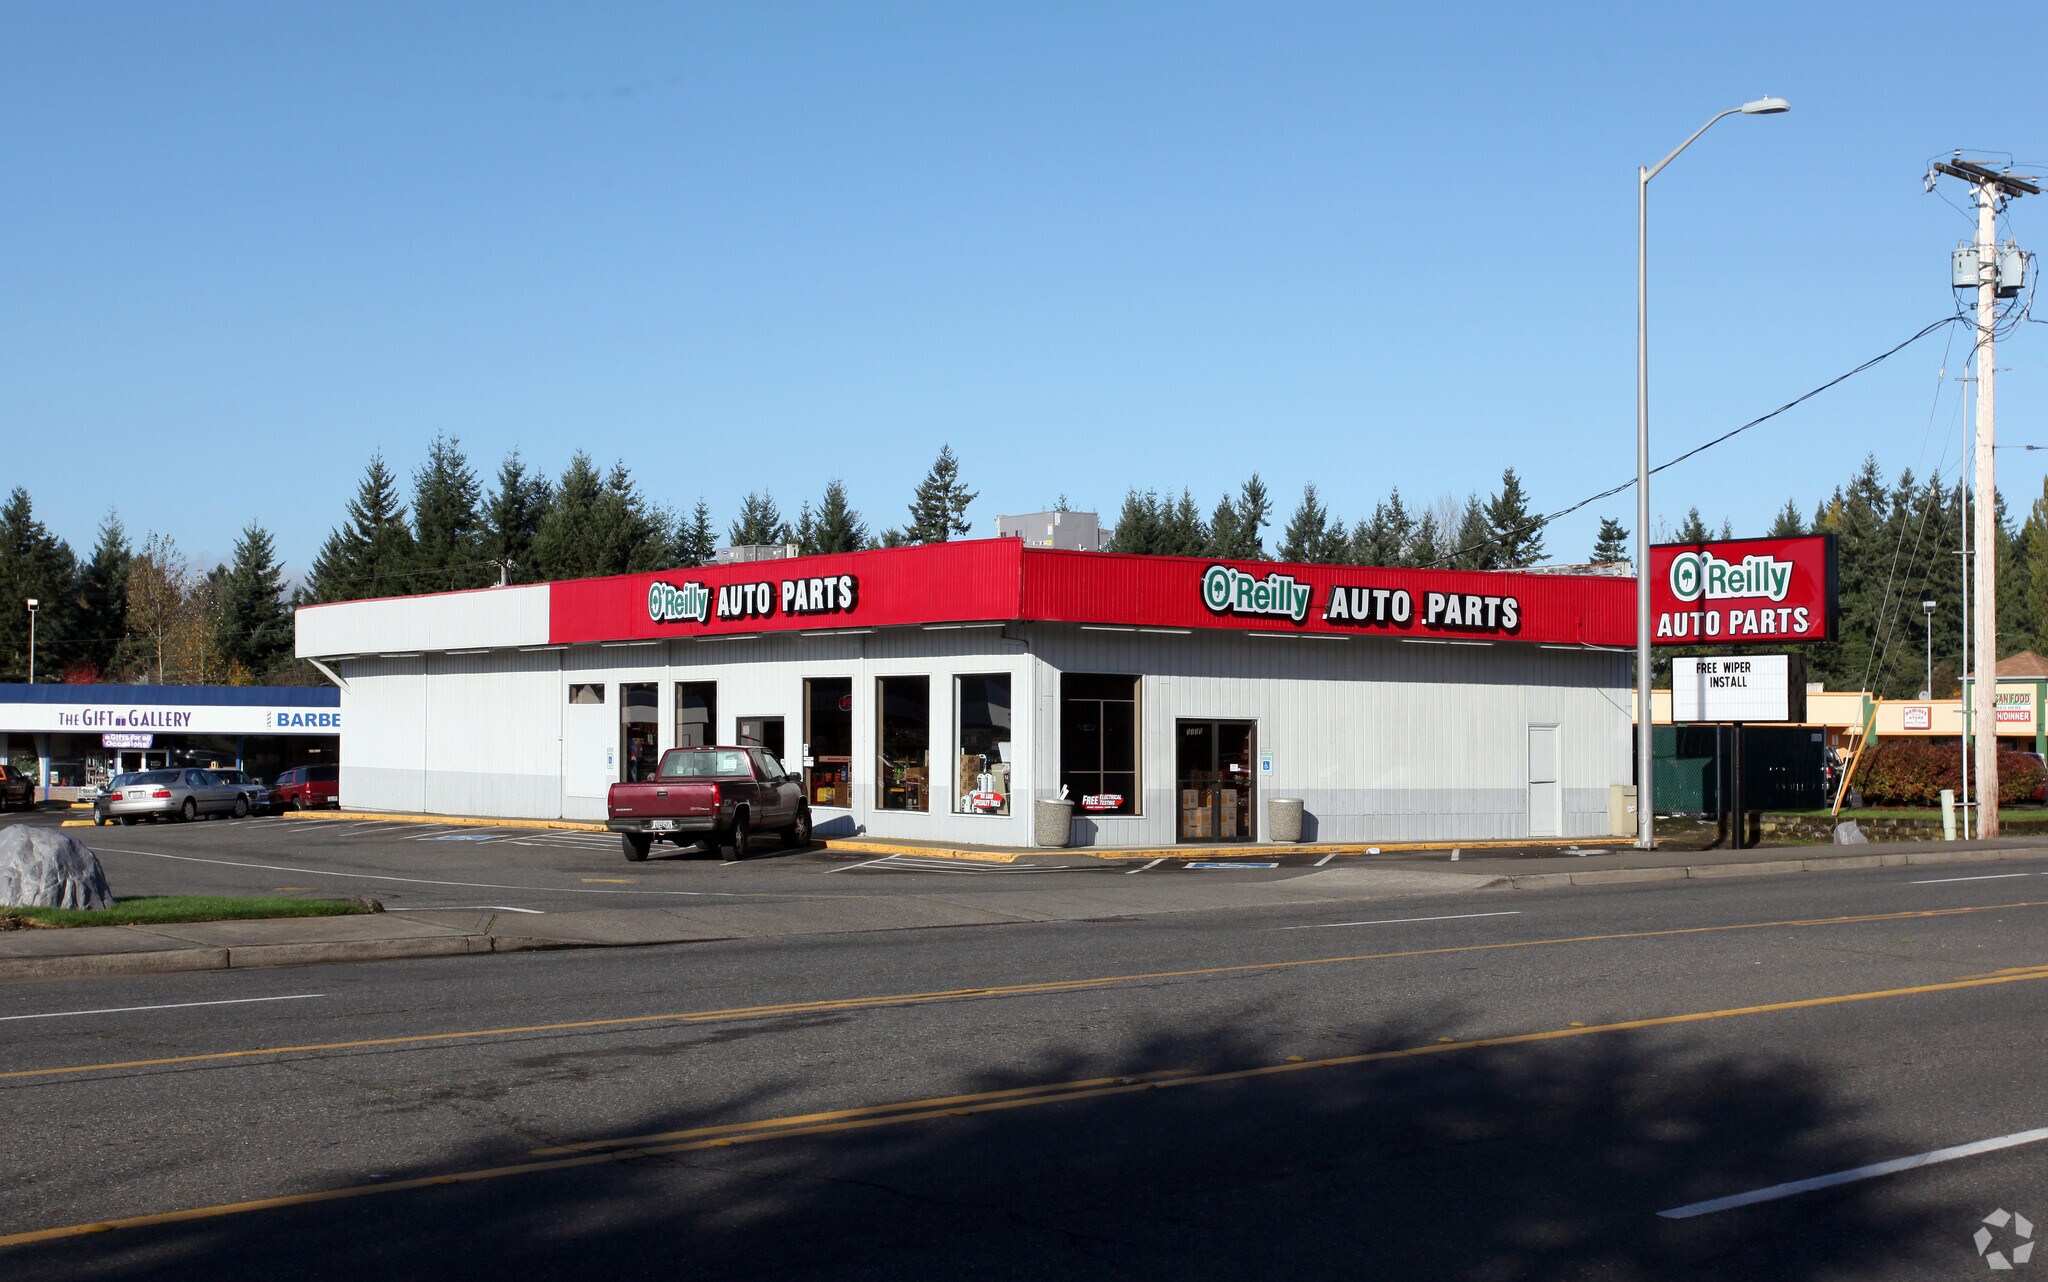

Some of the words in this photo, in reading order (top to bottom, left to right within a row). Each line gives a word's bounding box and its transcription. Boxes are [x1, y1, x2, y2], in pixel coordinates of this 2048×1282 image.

[1669, 551, 1793, 601] O'Reilly
[648, 582, 709, 622] O'Reilly
[716, 582, 771, 617] AUTO
[781, 575, 852, 612] PARTS
[1203, 565, 1310, 621] O'Reilly
[1329, 587, 1410, 622] AUTO
[1428, 592, 1518, 629] PARTS
[1656, 611, 1720, 637] AUTO
[1729, 607, 1809, 635] PARTS
[1696, 662, 1717, 674] FREE
[1723, 661, 1751, 673] WIPER
[1709, 676, 1747, 688] INSTALL
[2011, 693, 2030, 704] FOOD
[59, 712, 79, 726] THE
[82, 708, 114, 726] GIFT
[128, 709, 191, 727] GALLERY
[277, 713, 340, 727] BARBE
[1082, 795, 1099, 805] FREE
